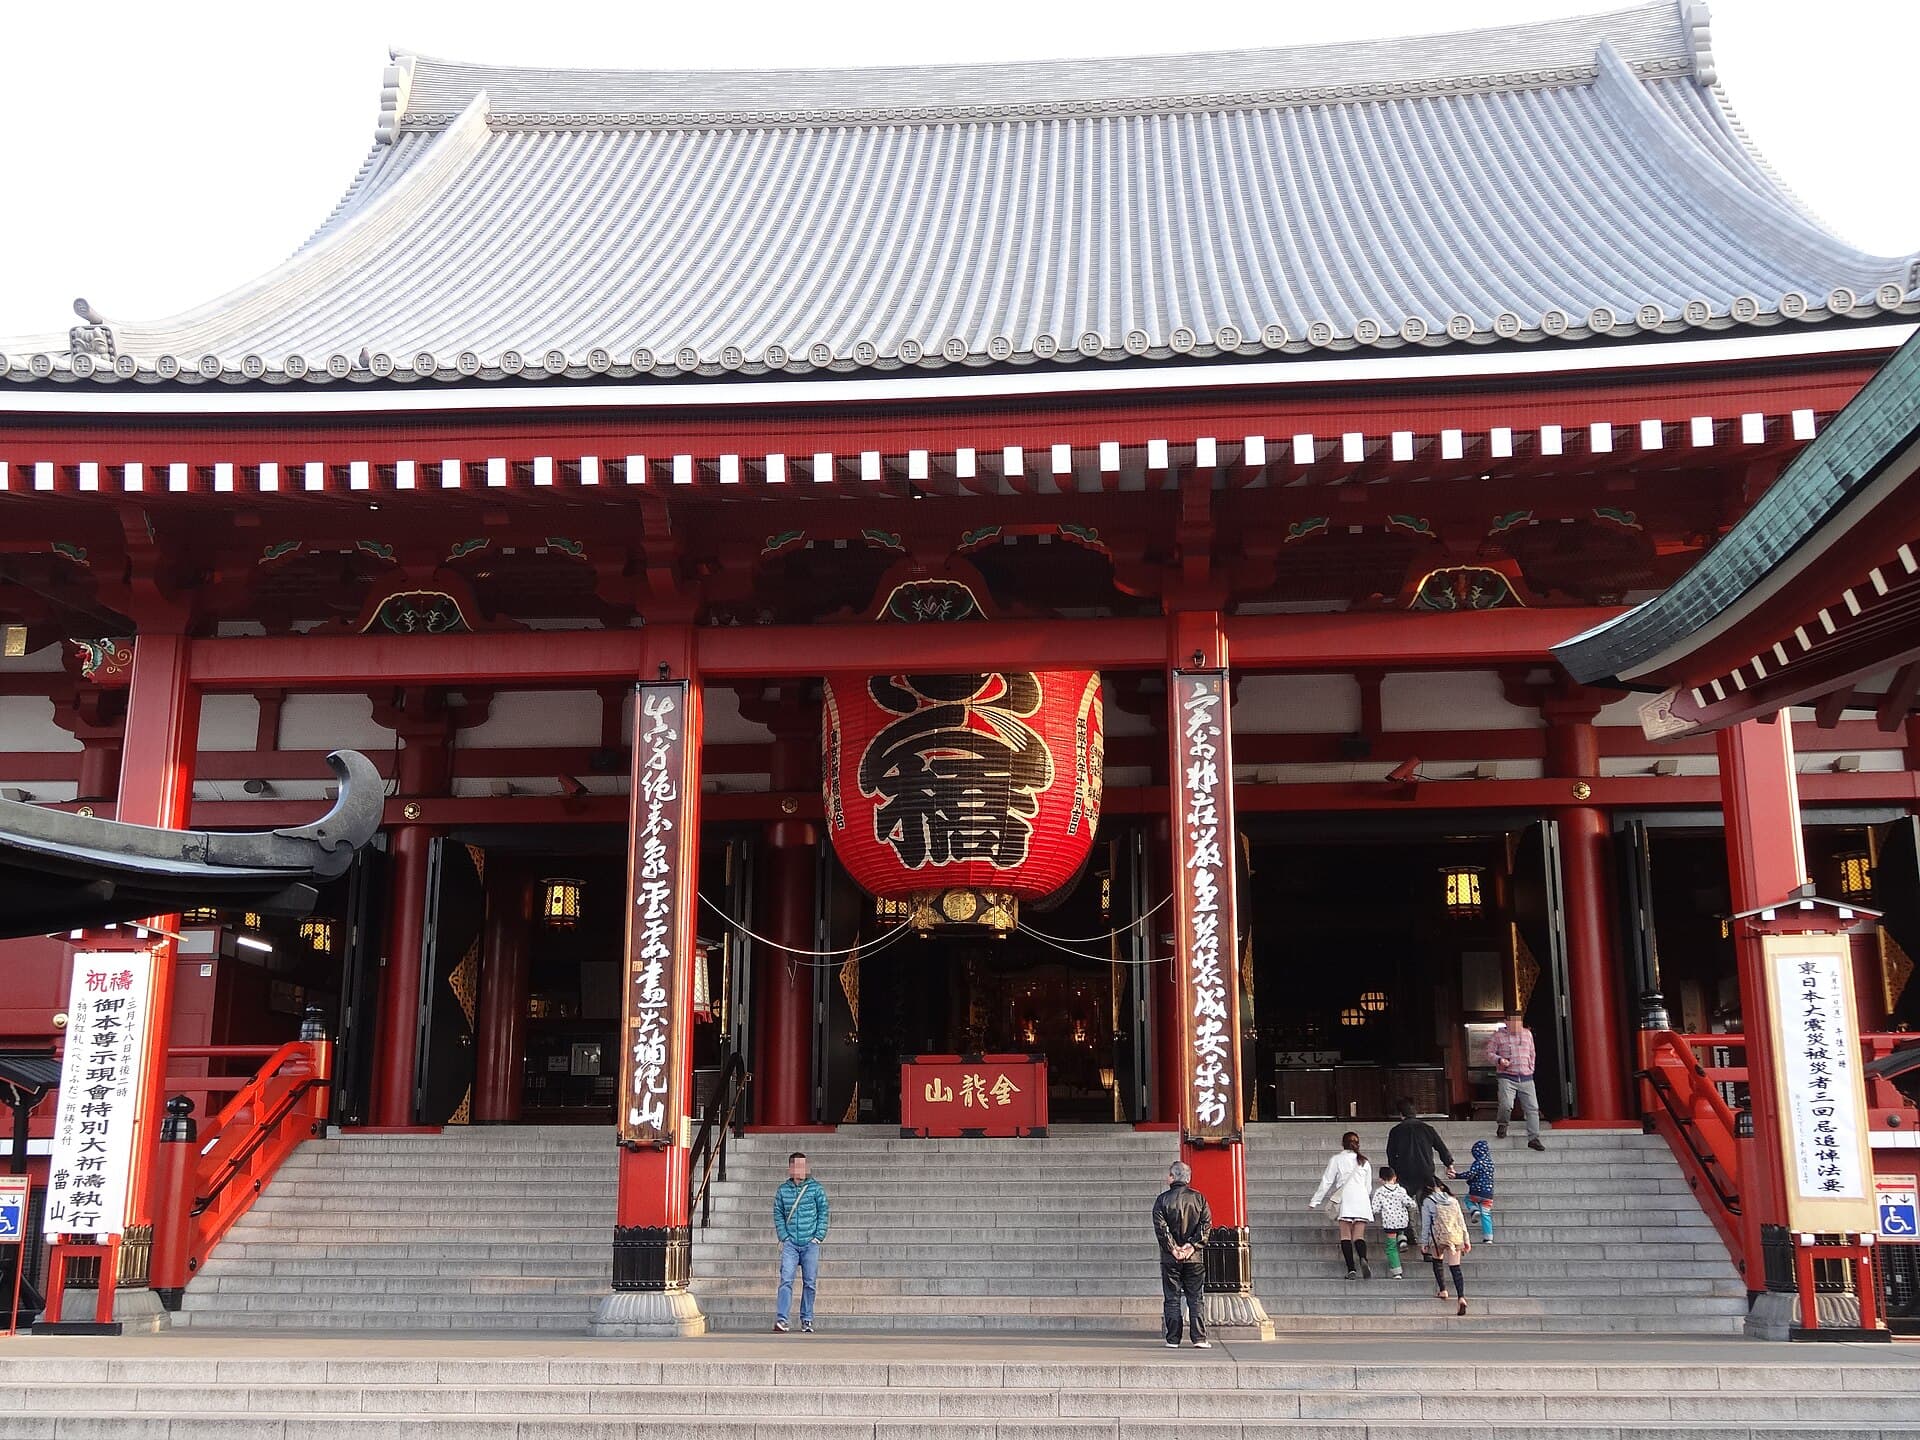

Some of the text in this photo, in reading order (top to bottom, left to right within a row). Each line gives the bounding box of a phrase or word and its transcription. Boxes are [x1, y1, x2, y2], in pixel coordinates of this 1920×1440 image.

[1797, 961, 1845, 1194] 東日本大震災被災者三回忌追悼法要
